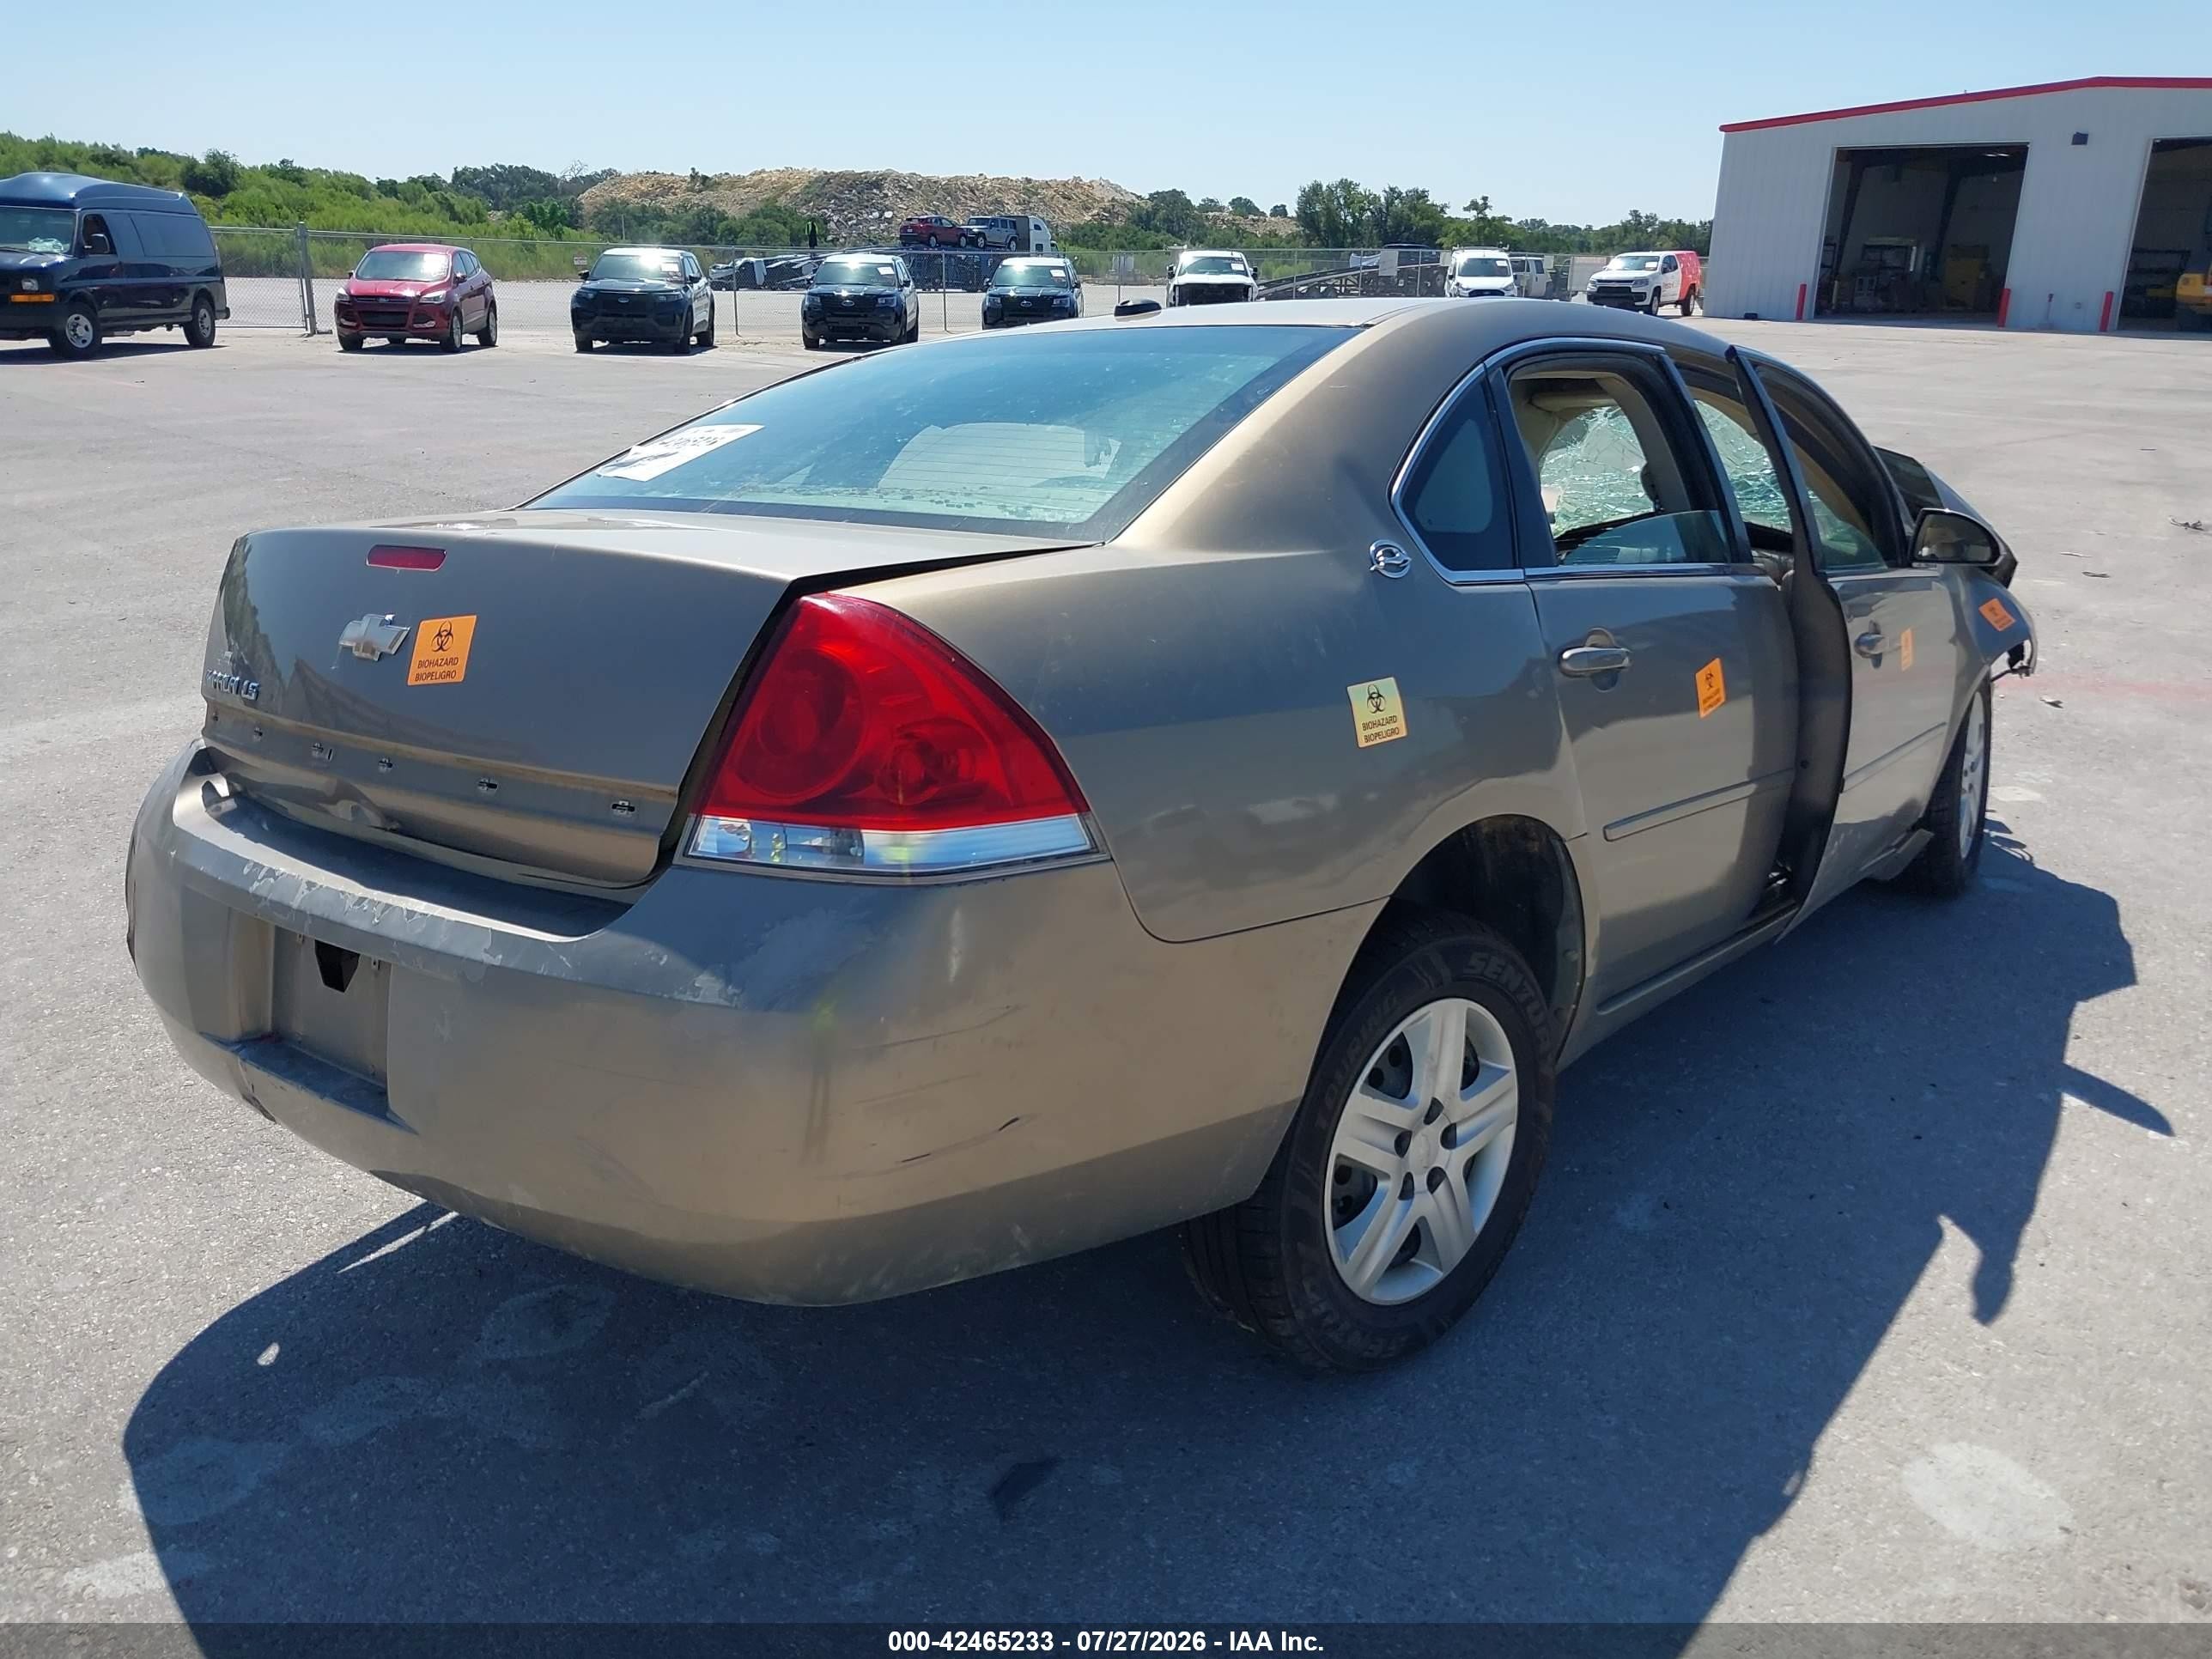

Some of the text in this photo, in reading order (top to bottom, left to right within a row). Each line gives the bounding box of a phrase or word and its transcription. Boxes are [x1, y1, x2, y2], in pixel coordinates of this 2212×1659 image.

[417, 657, 459, 669] BIOHAZARD
[415, 670, 457, 682] BIOPELIGRO
[241, 679, 259, 700] LS
[1362, 715, 1397, 731] BIOHAZARD
[1364, 727, 1400, 743] BIOPELIGRO
